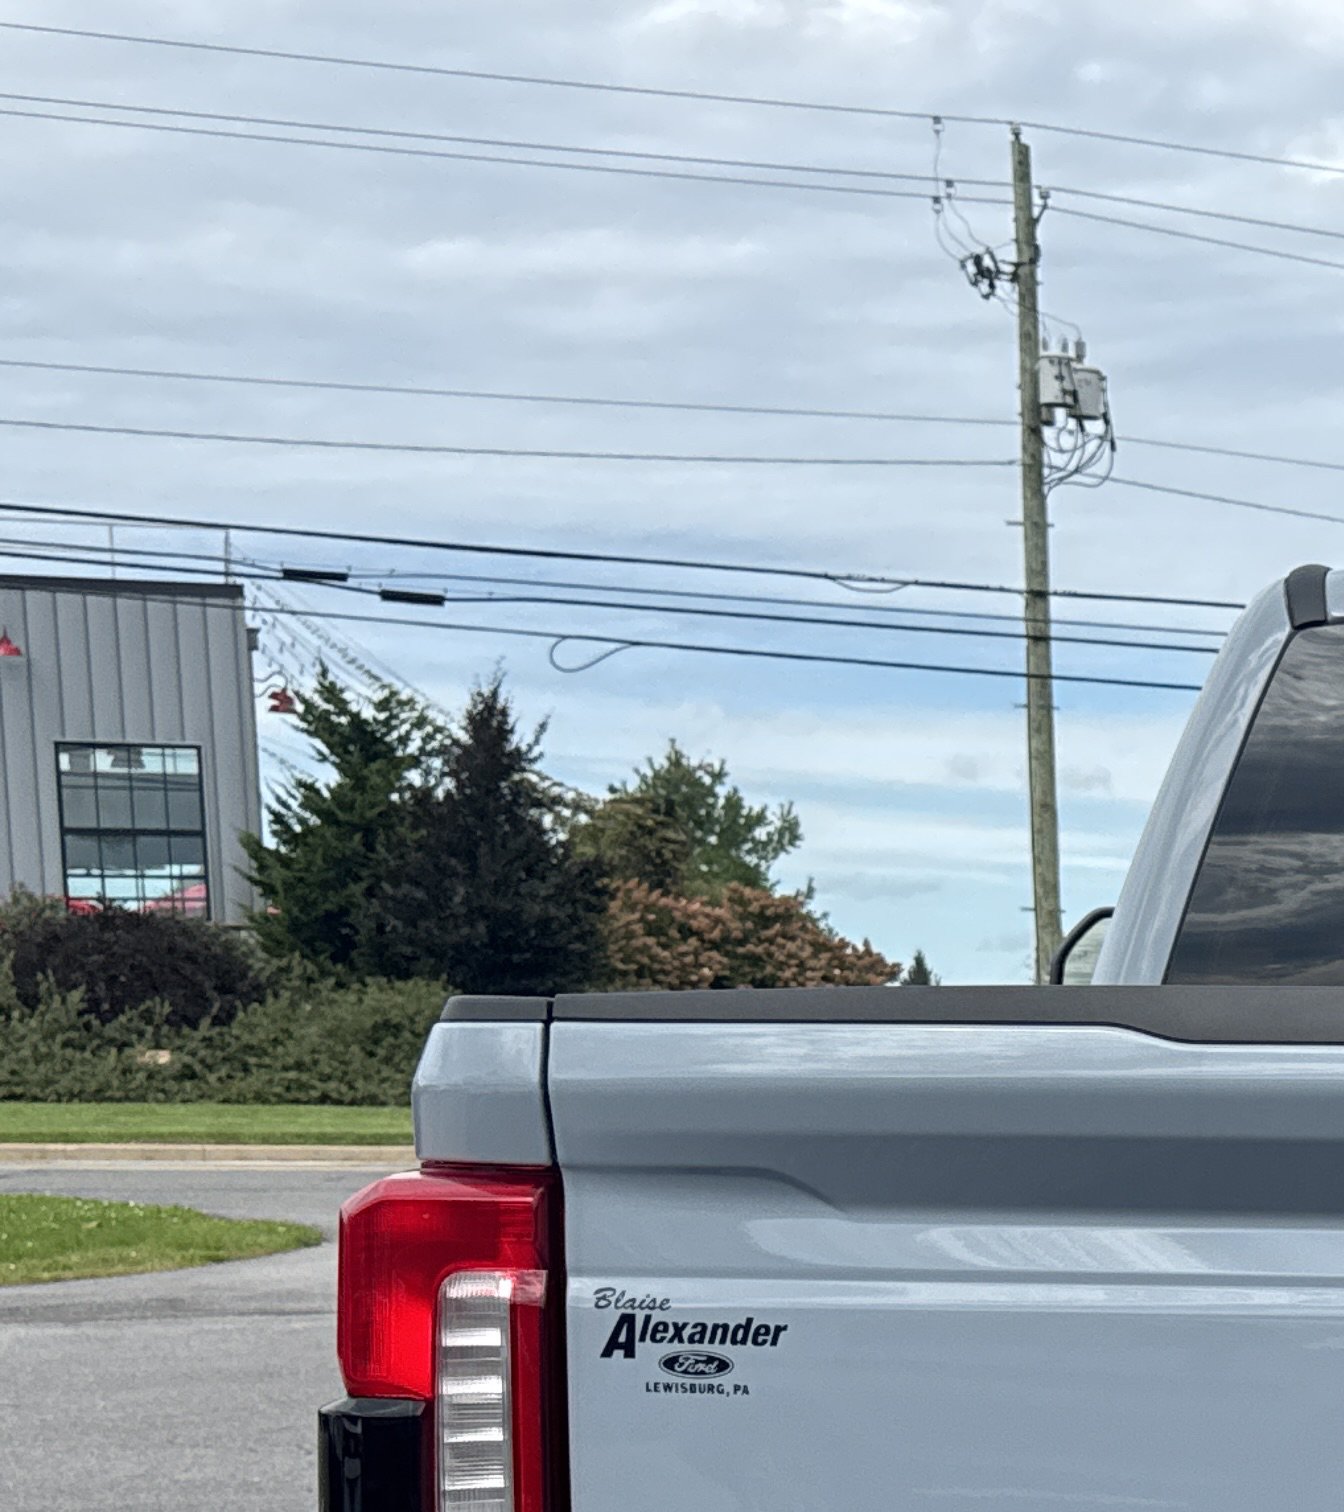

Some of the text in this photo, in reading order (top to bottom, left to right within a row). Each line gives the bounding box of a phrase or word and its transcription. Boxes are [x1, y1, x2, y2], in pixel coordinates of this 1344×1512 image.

[593, 1287, 672, 1311] Blaise
[600, 1312, 788, 1359] Alexander
[674, 1354, 719, 1374] Ford
[645, 1381, 750, 1397] LEWISBURG, PA
